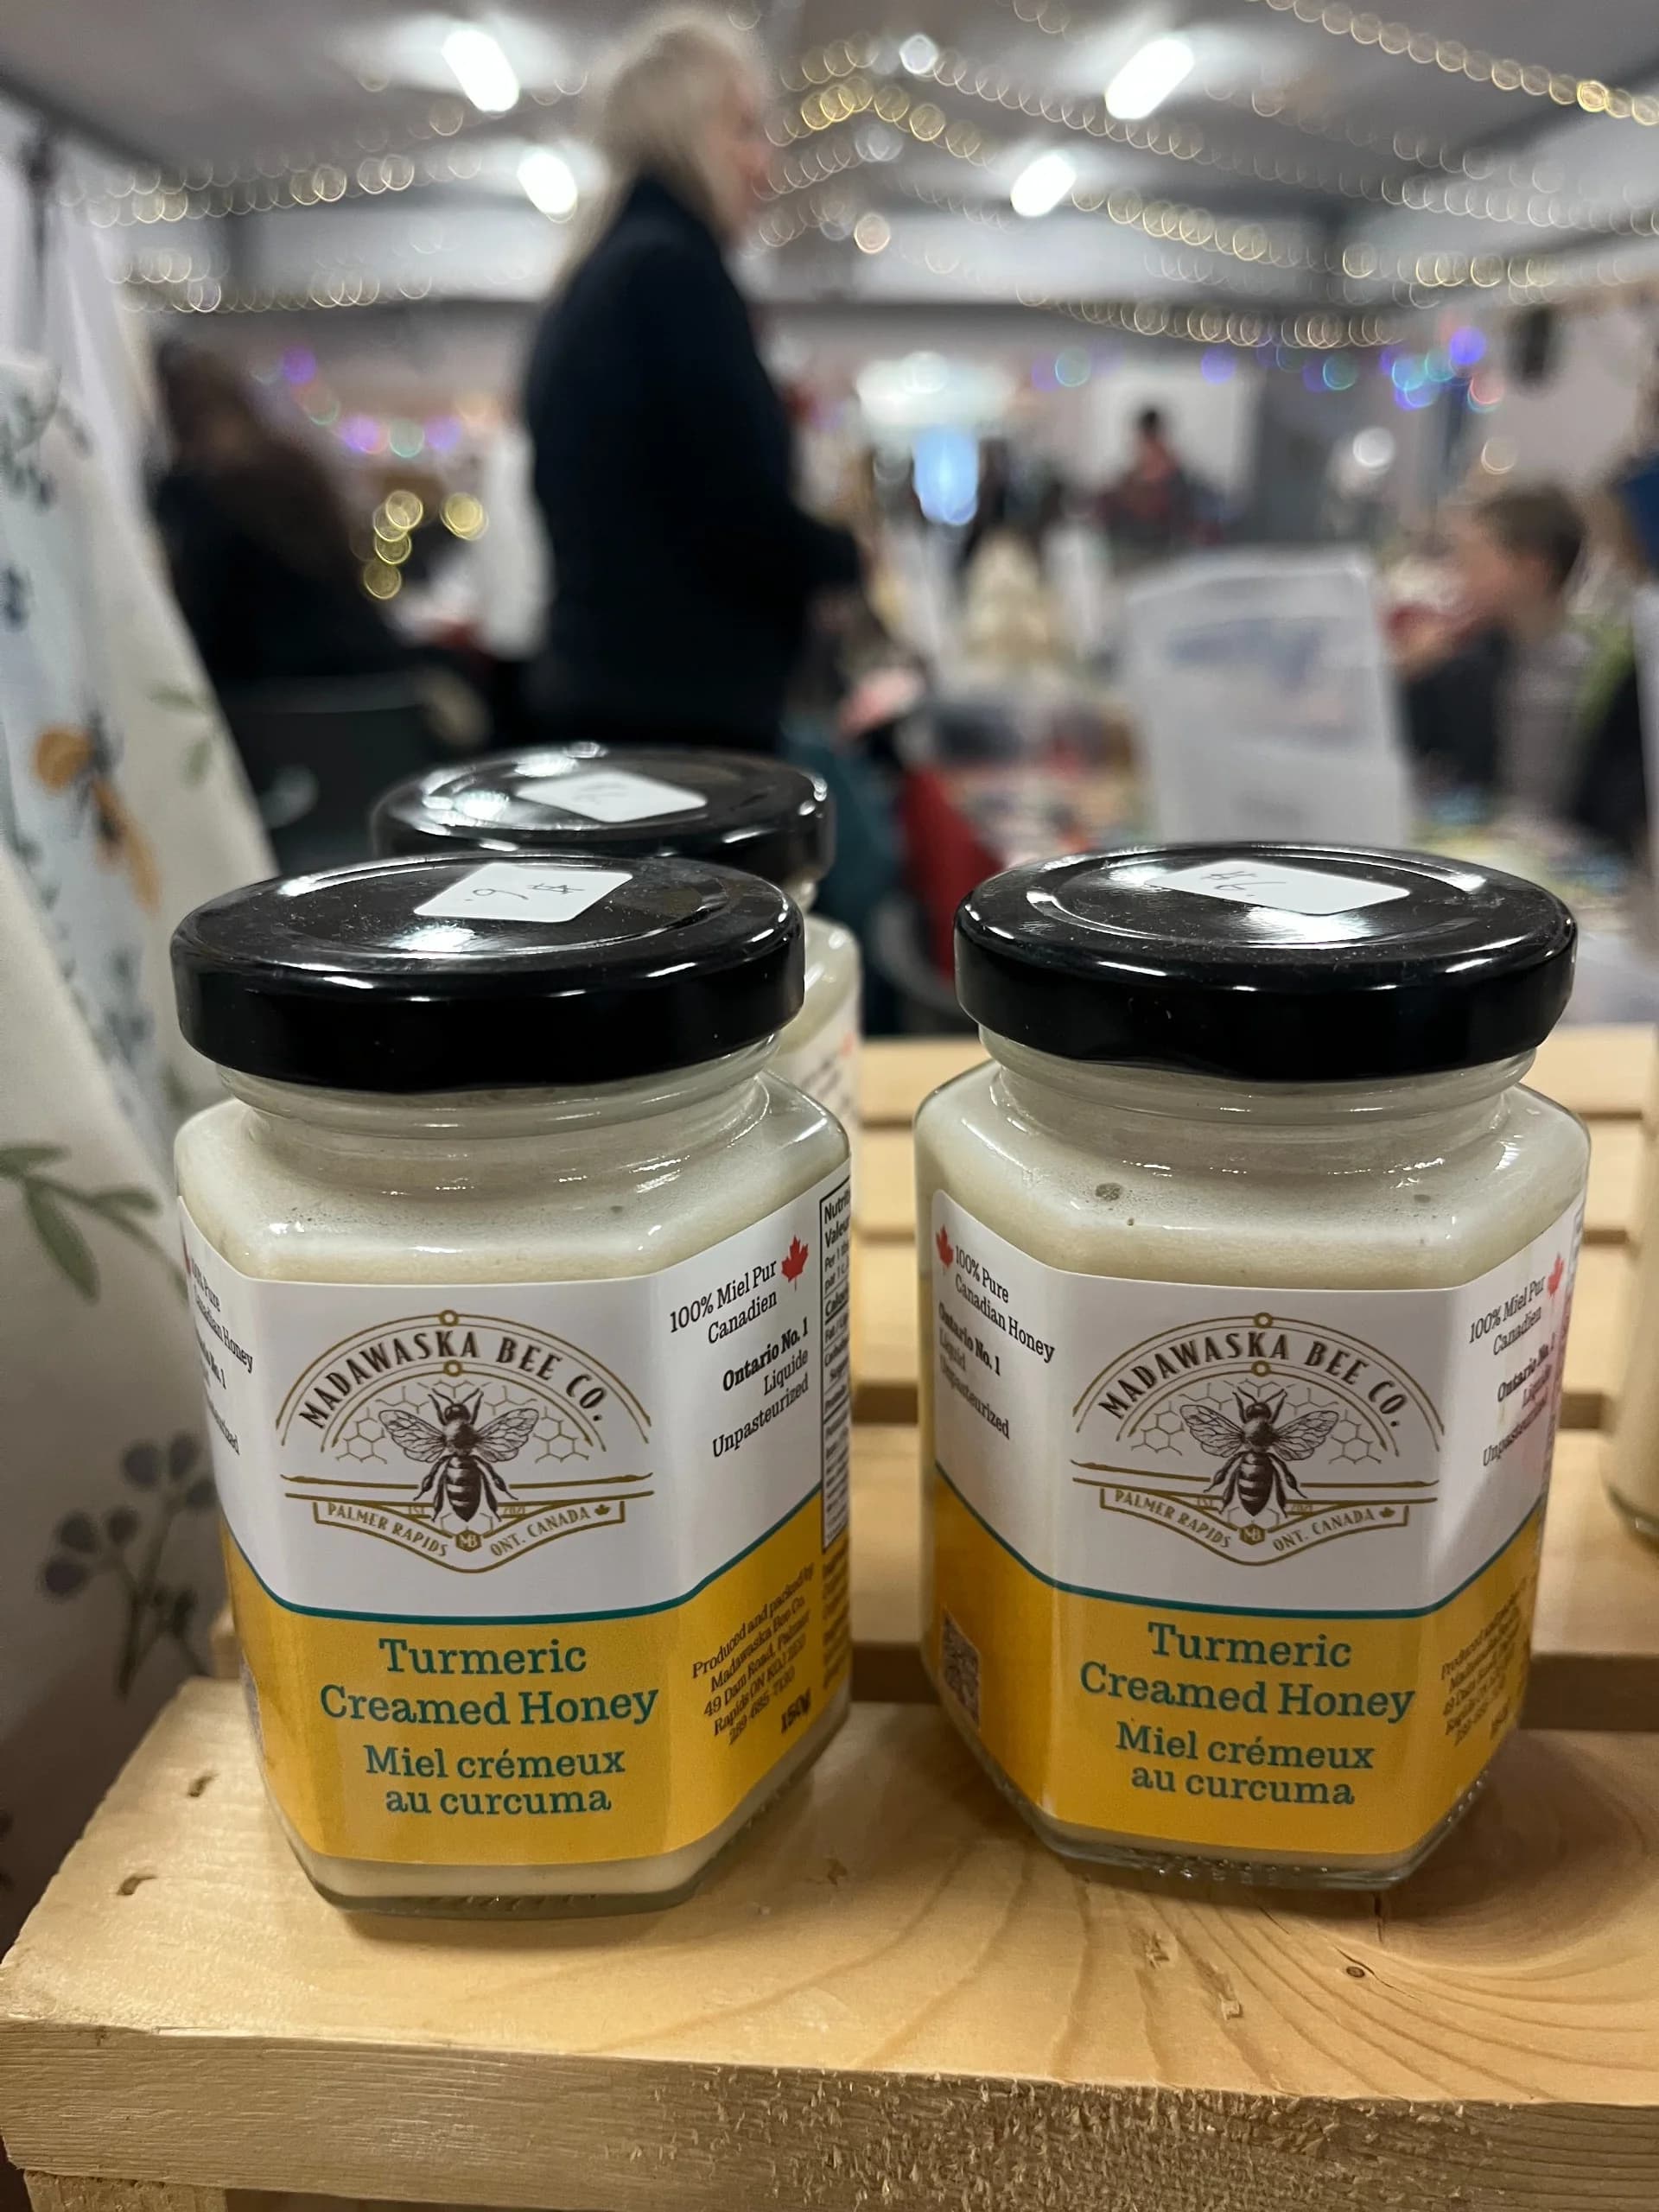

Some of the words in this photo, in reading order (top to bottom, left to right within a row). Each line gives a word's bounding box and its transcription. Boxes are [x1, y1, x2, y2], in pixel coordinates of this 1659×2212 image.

[670, 1292, 715, 1333] 100%
[716, 1272, 751, 1310] Miel
[753, 1260, 778, 1290] Pur
[955, 1244, 981, 1282] 100%
[982, 1267, 1009, 1304] Pure
[707, 1291, 778, 1344] Canadien
[938, 1301, 974, 1351] Ontario
[974, 1337, 993, 1370] No.
[995, 1355, 1001, 1376] 1
[955, 1273, 1007, 1332] Canadian
[1007, 1314, 1056, 1364] Honey
[1469, 1305, 1502, 1344] 100%
[1502, 1286, 1528, 1322] Miel
[222, 1325, 253, 1374] Honey
[722, 1343, 779, 1391] Ontario
[780, 1328, 800, 1355] No.
[802, 1316, 809, 1338] 1
[763, 1348, 809, 1396] Liquide
[299, 1330, 480, 1429] MADAWASKA
[495, 1336, 563, 1382] BEE
[565, 1373, 607, 1422] CO.
[1098, 1331, 1290, 1420] MADAWASKA
[1303, 1340, 1370, 1385] BEE
[1368, 1380, 1408, 1427] CO.
[712, 1371, 810, 1458] Unpasteurized
[327, 1501, 388, 1530] PALMER
[391, 1522, 448, 1557] RAPIDS
[489, 1535, 526, 1557] ONT.
[526, 1505, 591, 1538] CANADA
[1114, 1489, 1174, 1521] PALMER
[1178, 1511, 1231, 1549] RAPIDS
[1272, 1529, 1309, 1553] ONT.
[1312, 1508, 1376, 1536] CANADA
[378, 1637, 587, 1675] Turmeric
[691, 1621, 747, 1679] Produced
[1147, 1621, 1351, 1668] Turmeric
[320, 1683, 511, 1726] Creamed
[518, 1688, 659, 1726] Honey
[703, 1695, 722, 1718] 49
[1080, 1660, 1268, 1714] Creamed
[1277, 1682, 1416, 1724] Honey
[363, 1744, 448, 1778] Miel
[456, 1747, 626, 1779] crémeux
[1115, 1720, 1199, 1760] Miel
[1206, 1736, 1376, 1770] crémeux
[385, 1789, 432, 1814] au
[440, 1789, 612, 1815] curcuma
[1130, 1765, 1176, 1792] au
[1185, 1771, 1356, 1805] curcuma
